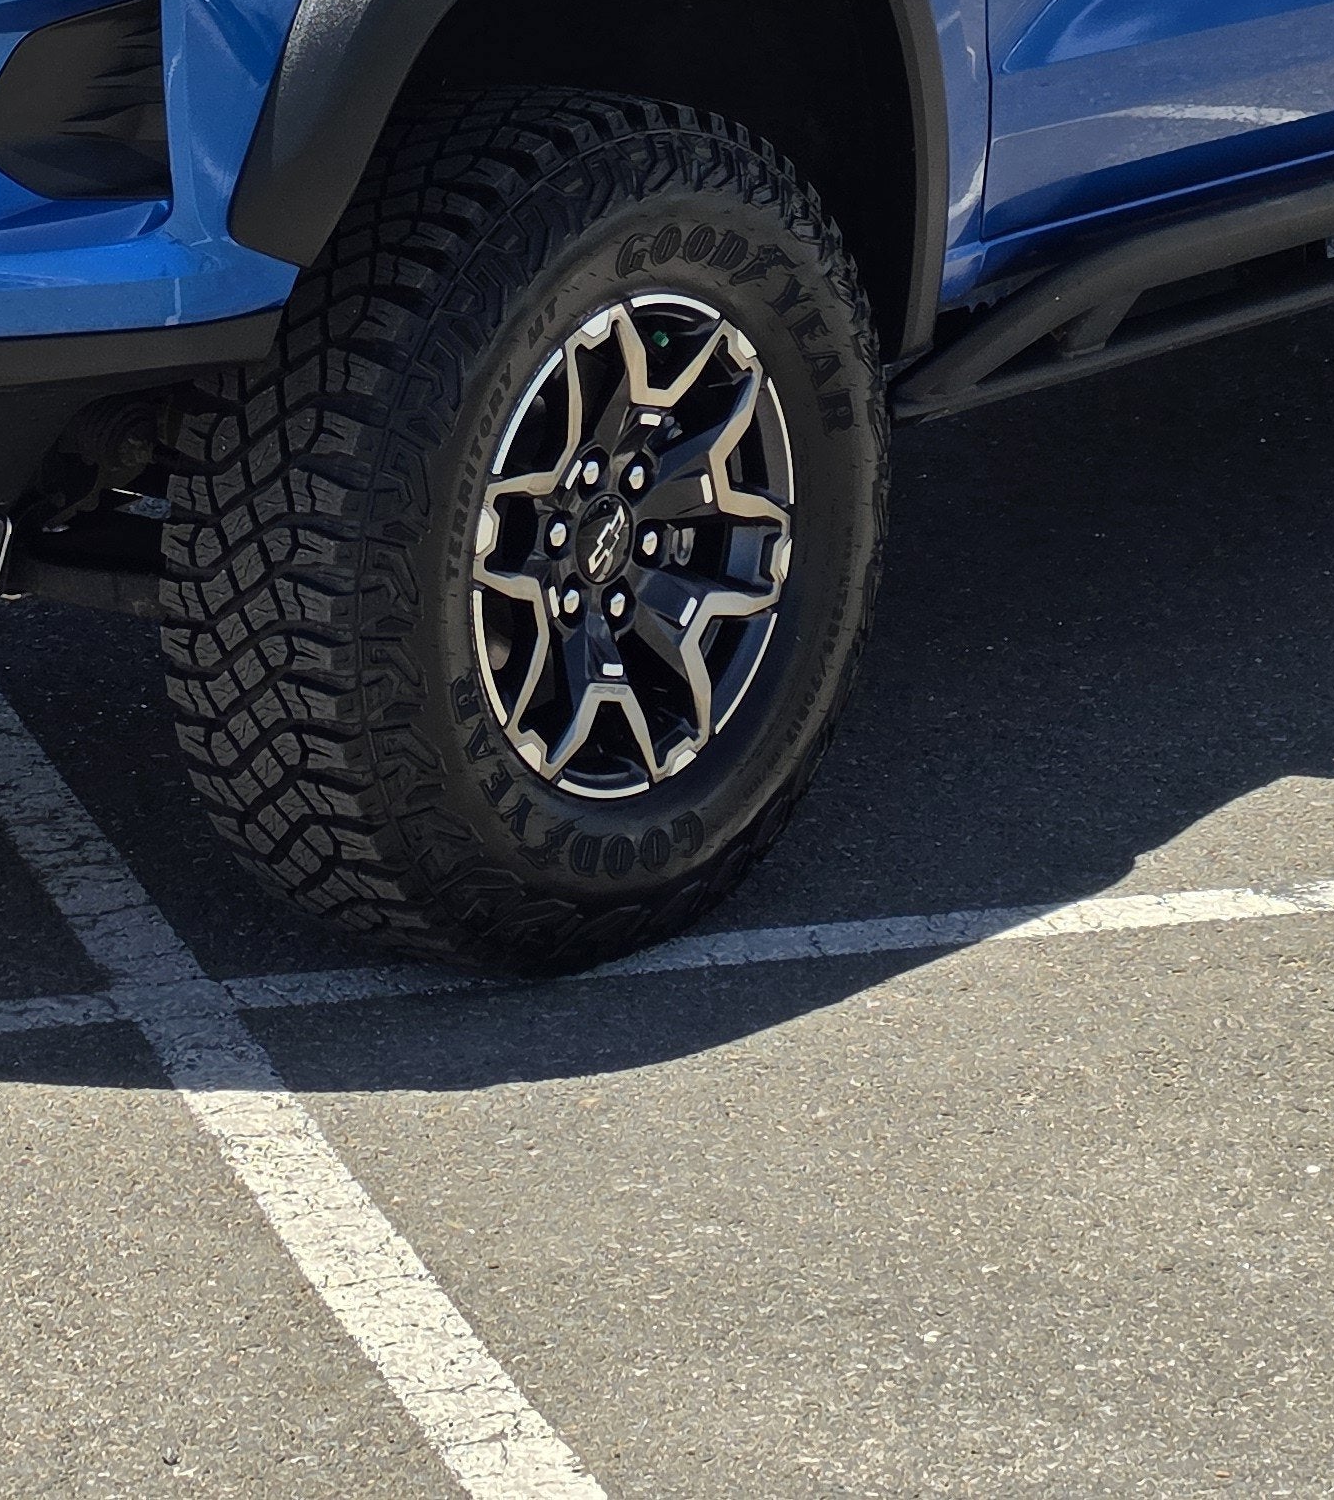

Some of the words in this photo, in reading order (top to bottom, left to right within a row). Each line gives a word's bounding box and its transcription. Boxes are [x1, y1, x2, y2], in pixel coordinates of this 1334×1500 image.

[615, 222, 856, 438] GOODYEAR
[445, 361, 512, 582] TERRITORY
[450, 670, 706, 879] GOODYEAR
